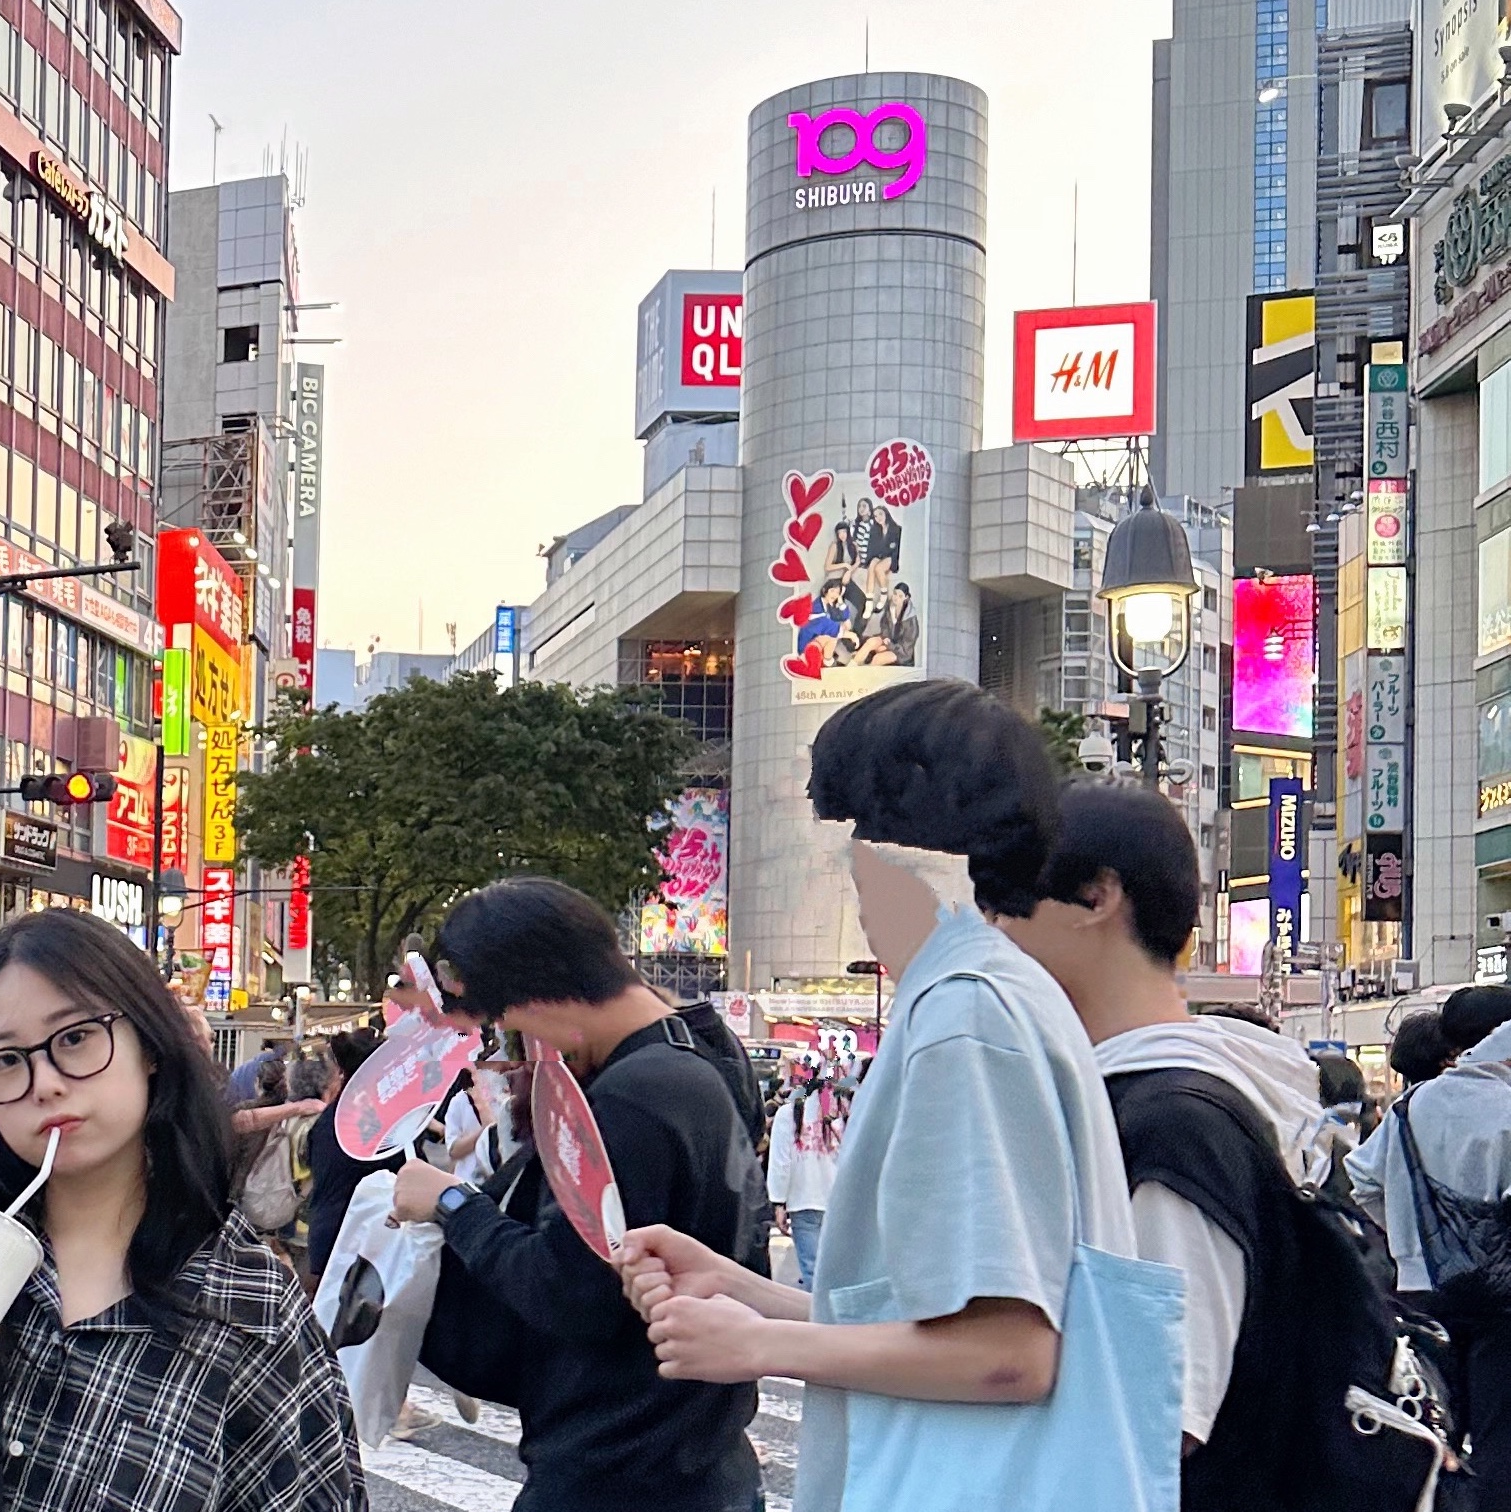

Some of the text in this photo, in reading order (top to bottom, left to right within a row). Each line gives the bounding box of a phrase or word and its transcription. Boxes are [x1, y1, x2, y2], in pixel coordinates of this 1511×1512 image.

[787, 102, 927, 201] 109
[795, 182, 876, 209] SHIBUYA
[692, 304, 743, 339] UN
[691, 342, 742, 382] QL
[1050, 348, 1120, 394] H&M
[299, 376, 319, 518] BIC CAMERA
[141, 621, 165, 652] 4F
[295, 606, 312, 644] 免税
[1387, 673, 1400, 717] フルーツ
[209, 729, 236, 820] 処方せん
[1371, 768, 1384, 811] フルーツ
[116, 784, 150, 826] アコム
[1280, 794, 1297, 860] MIZUHO
[91, 873, 144, 925] LUSH
